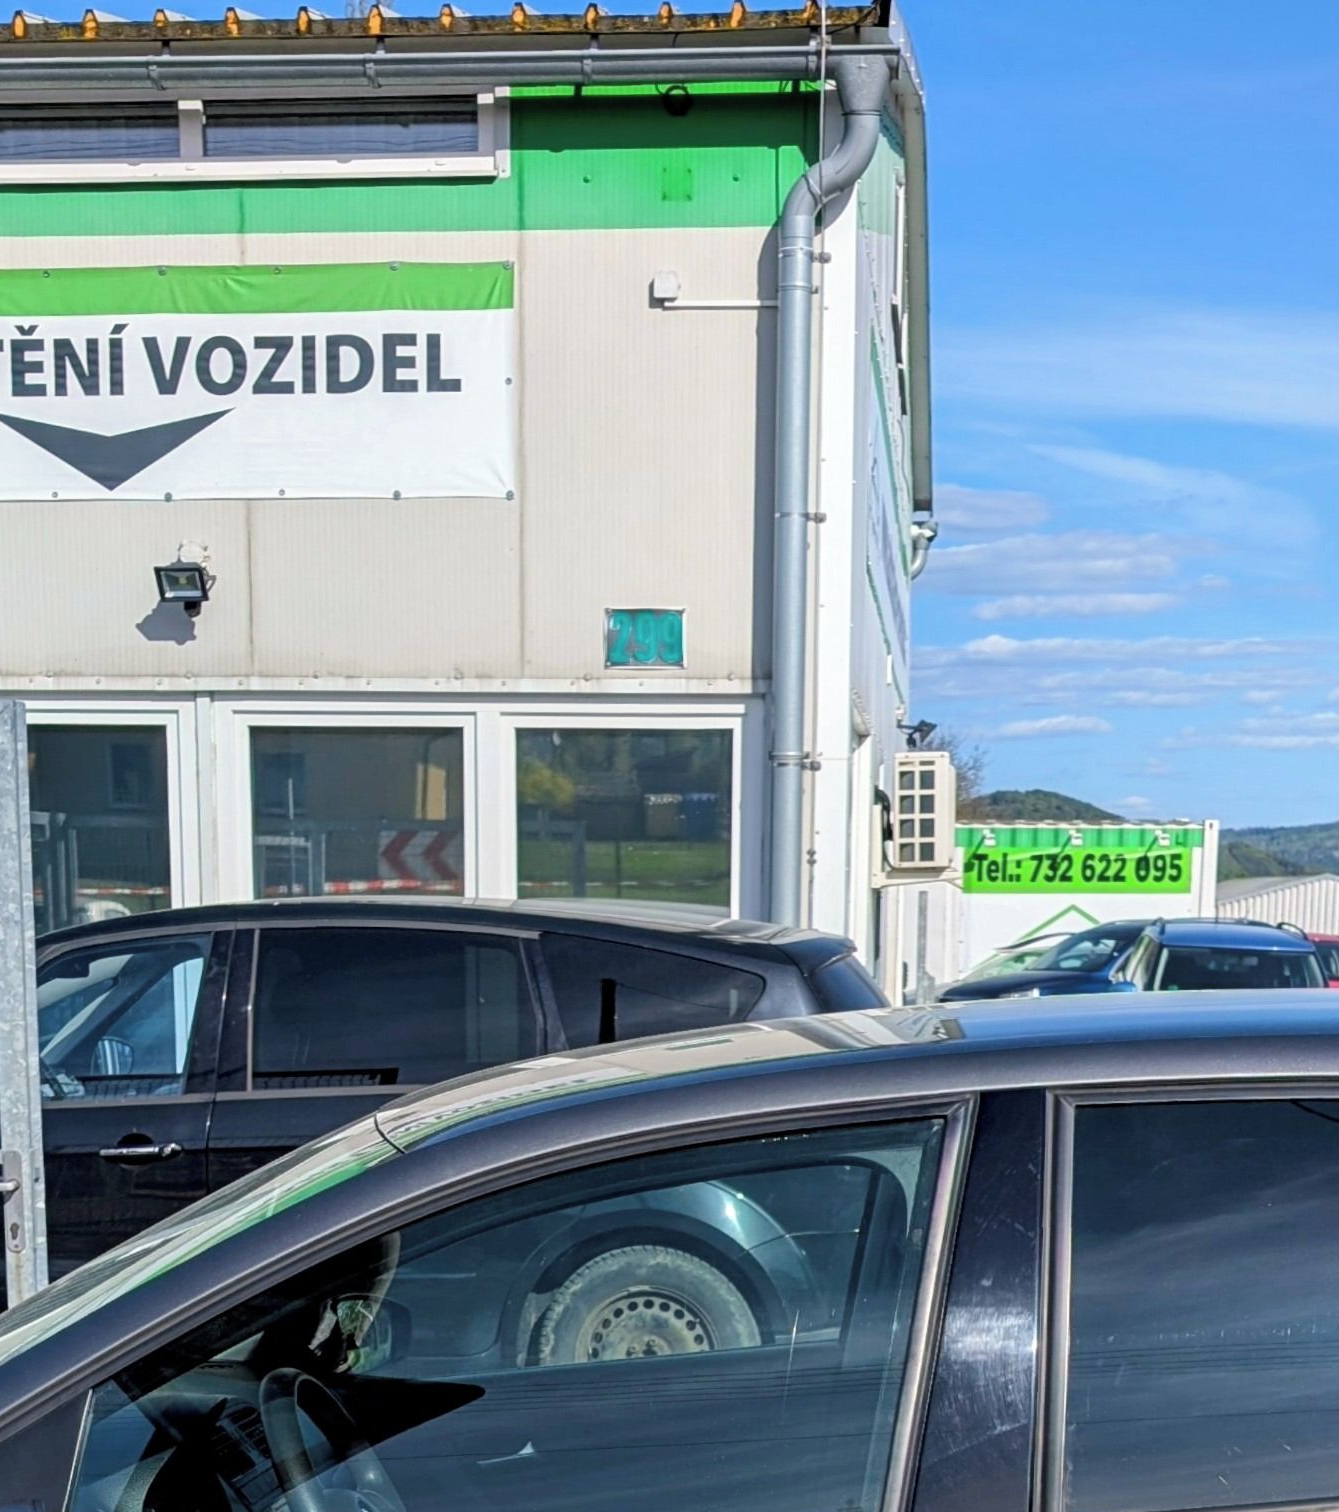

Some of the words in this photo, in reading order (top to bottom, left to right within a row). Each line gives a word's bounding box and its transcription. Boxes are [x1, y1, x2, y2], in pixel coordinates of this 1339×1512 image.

[142, 333, 462, 398] VOZIDEL
[974, 852, 1022, 883] Tel.:
[1029, 853, 1074, 883] 732
[1081, 853, 1126, 883] 622
[1134, 853, 1183, 883] 095
